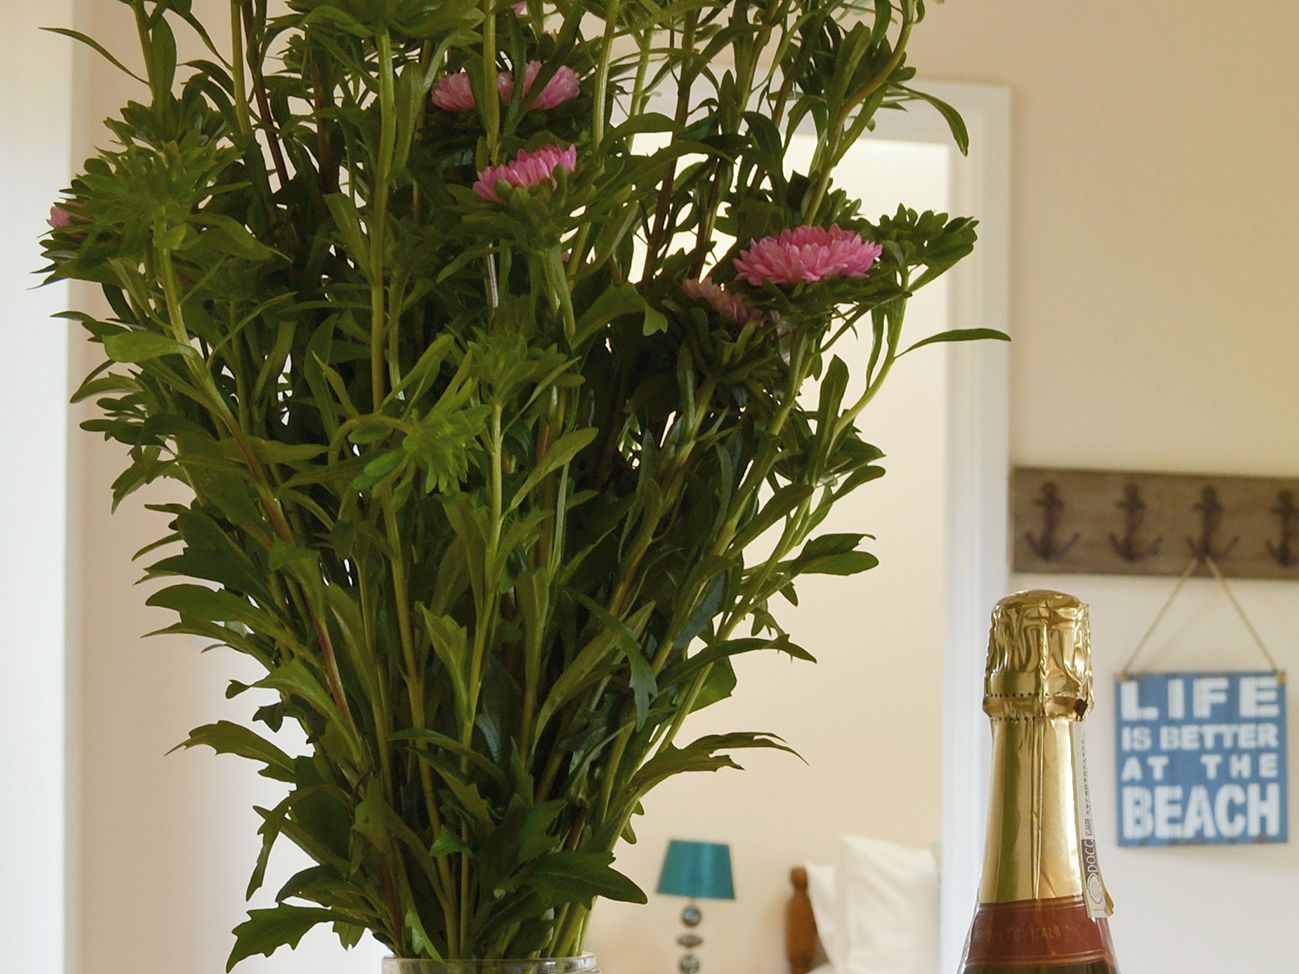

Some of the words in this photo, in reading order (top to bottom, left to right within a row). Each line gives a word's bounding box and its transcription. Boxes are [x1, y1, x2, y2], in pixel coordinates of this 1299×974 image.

[1120, 676, 1281, 720] LIFE
[1121, 727, 1152, 751] IS
[1160, 723, 1280, 751] BETTER
[1121, 755, 1169, 782] AT
[1199, 753, 1280, 780] THE
[1122, 783, 1281, 839] BEACH
